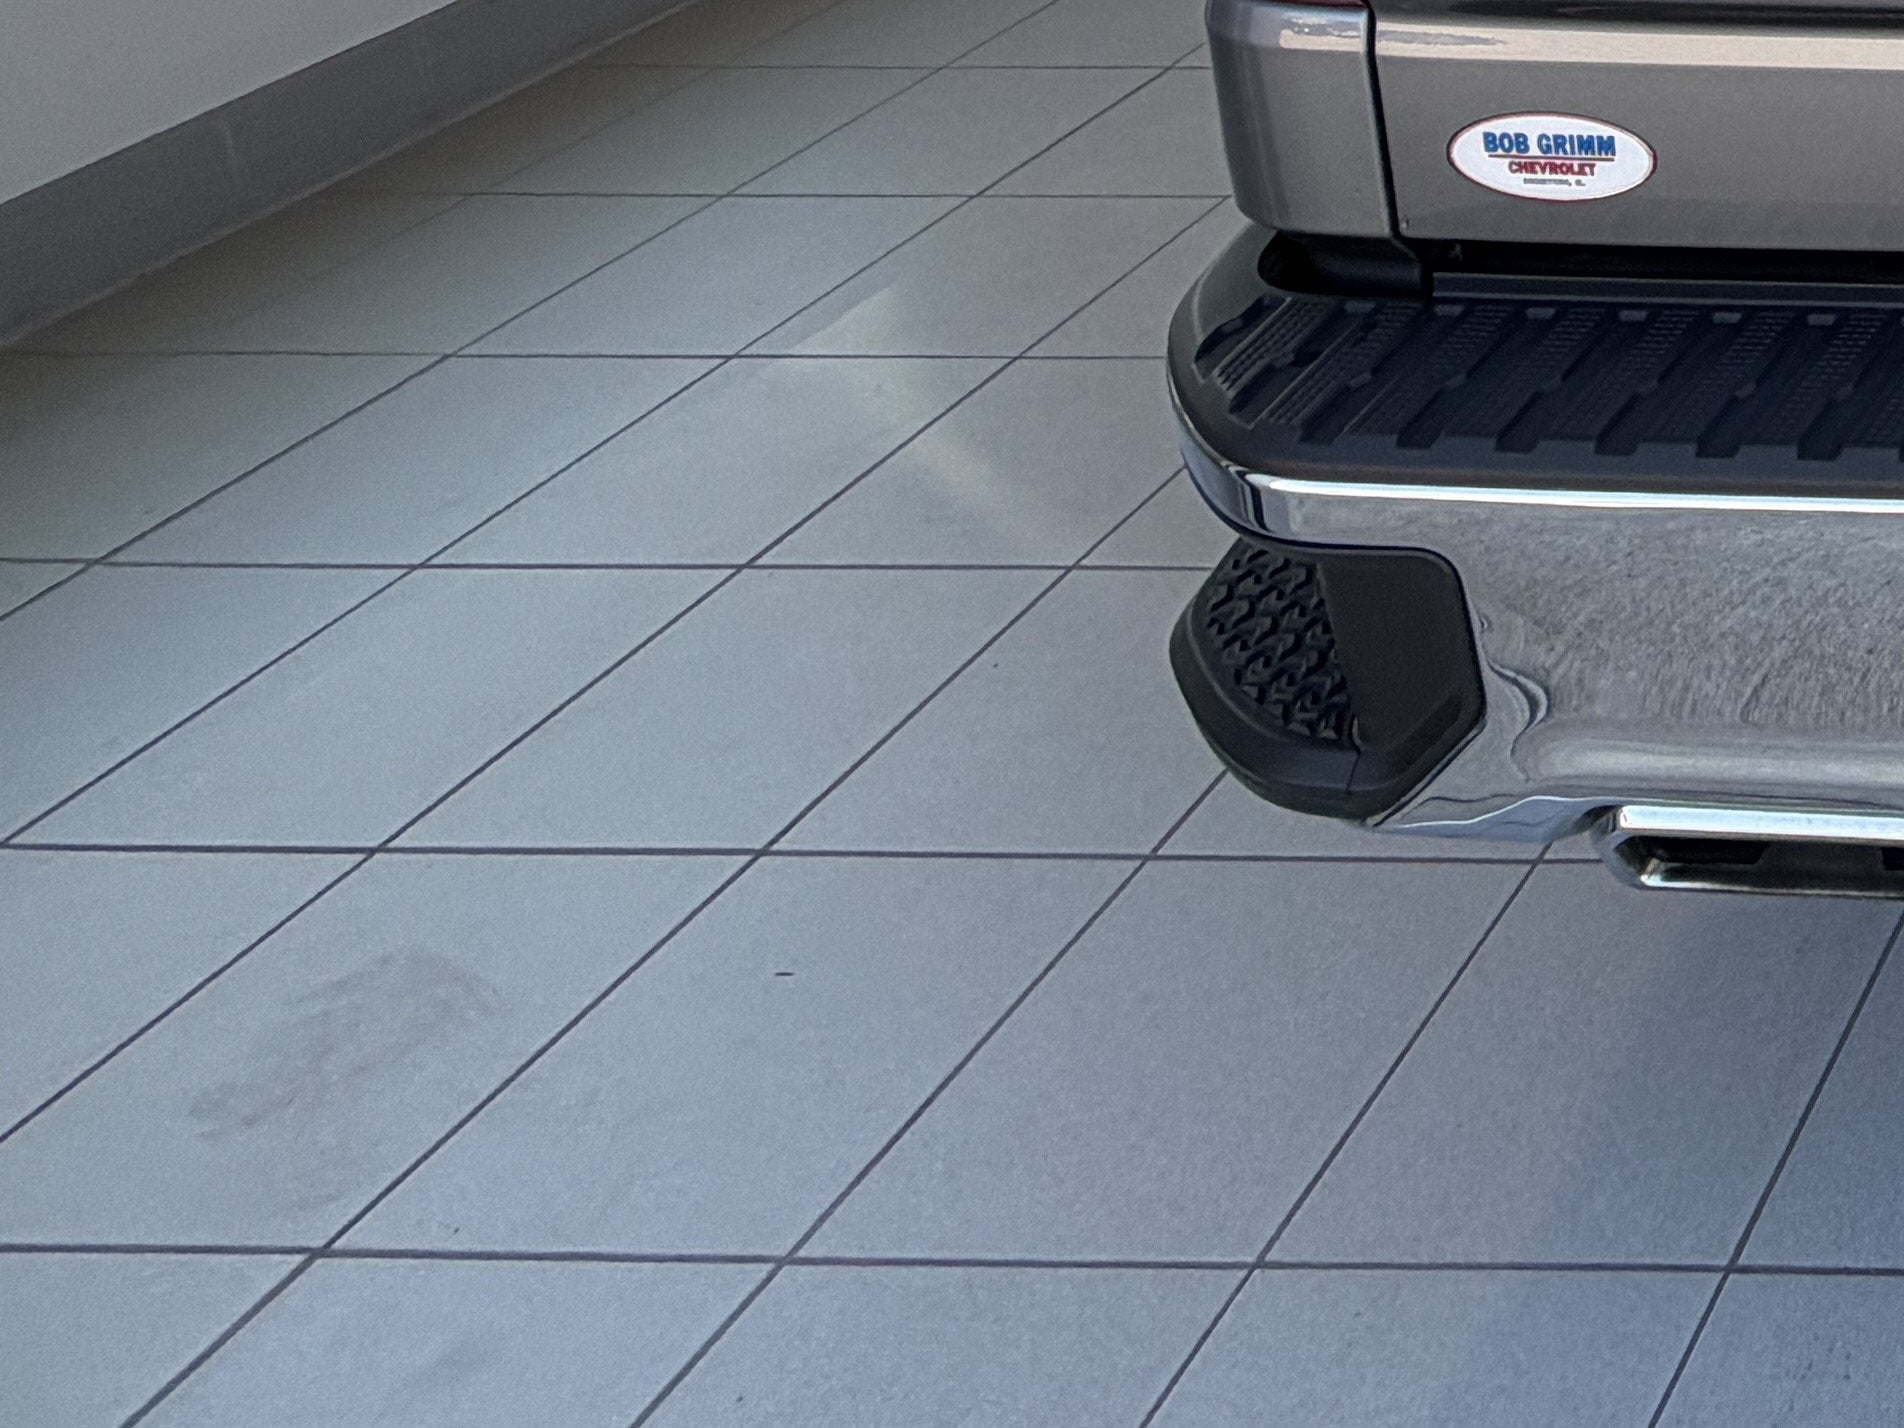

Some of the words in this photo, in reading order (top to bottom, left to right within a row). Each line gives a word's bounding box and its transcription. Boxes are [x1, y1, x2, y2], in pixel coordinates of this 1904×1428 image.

[1482, 131, 1530, 154] BOB
[1537, 133, 1616, 157] GRIMM
[1509, 160, 1596, 176] CHEVROLET
